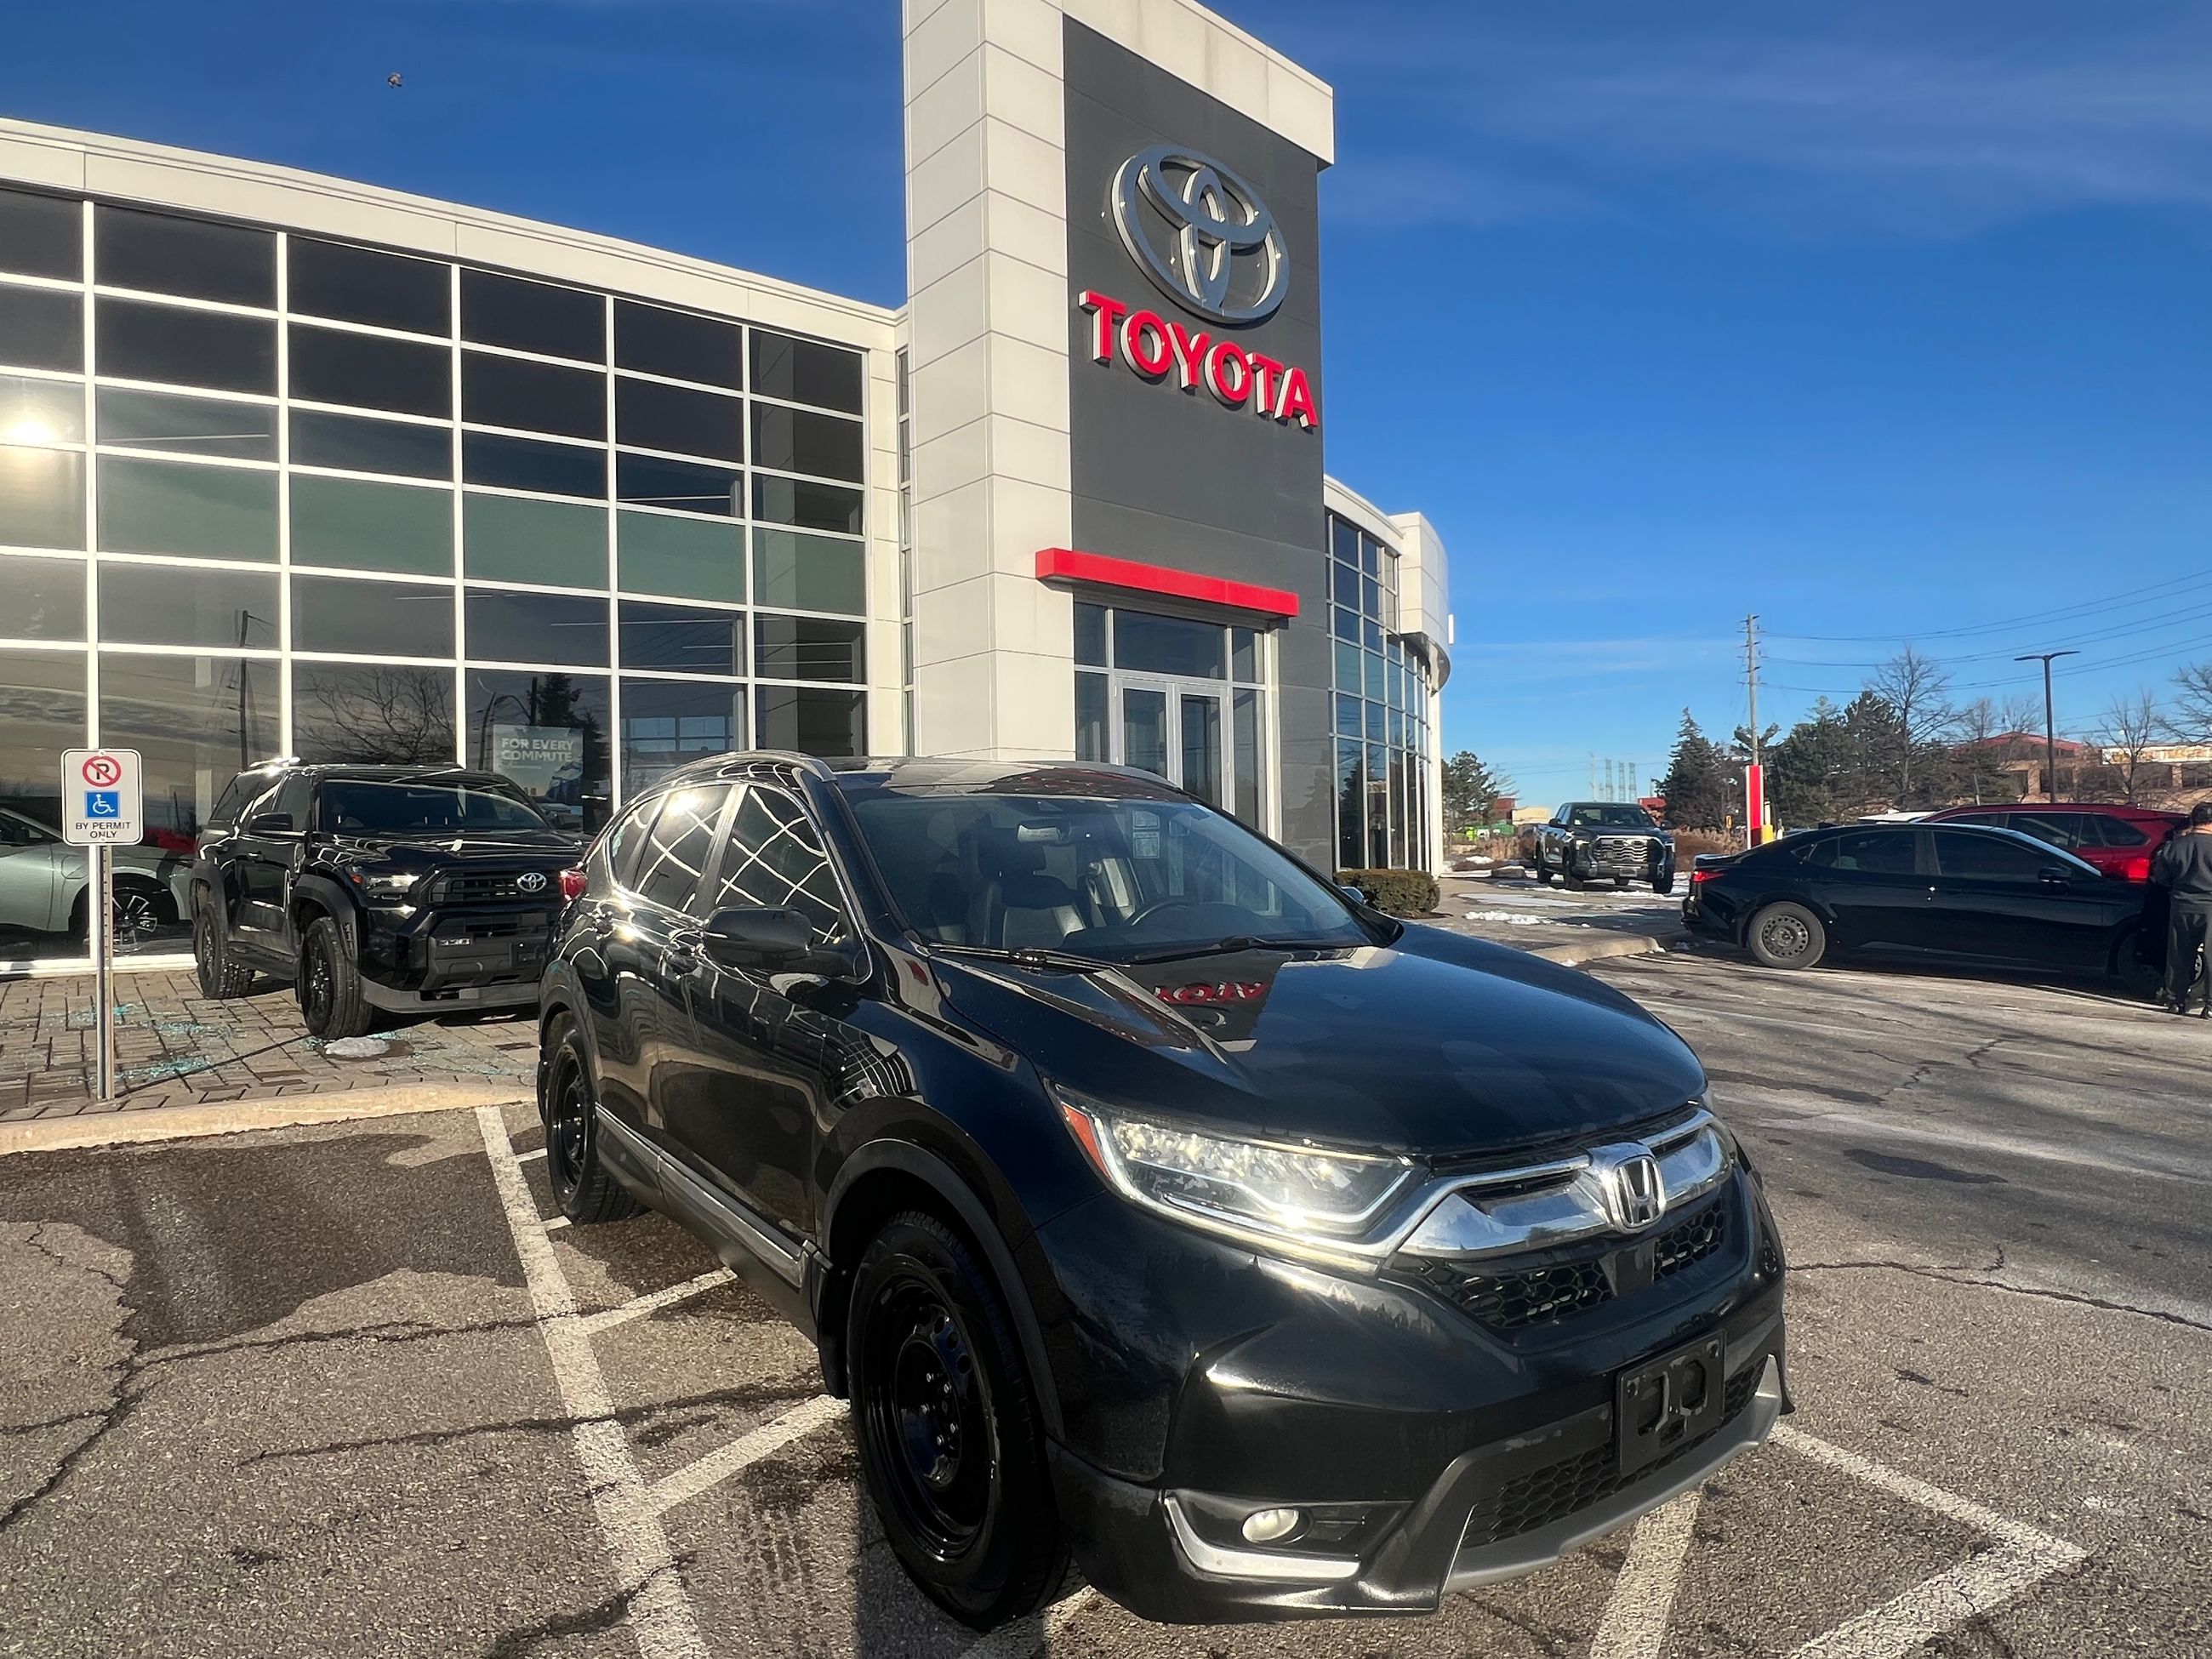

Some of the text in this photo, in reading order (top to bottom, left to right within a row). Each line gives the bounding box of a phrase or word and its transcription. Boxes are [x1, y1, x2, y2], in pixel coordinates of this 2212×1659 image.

[1079, 289, 1319, 428] TOYOTA
[501, 738, 574, 750] FOR EVERY
[500, 750, 573, 762] COMMUTE
[92, 821, 131, 830] PERMIT
[89, 830, 117, 839] ONLY
